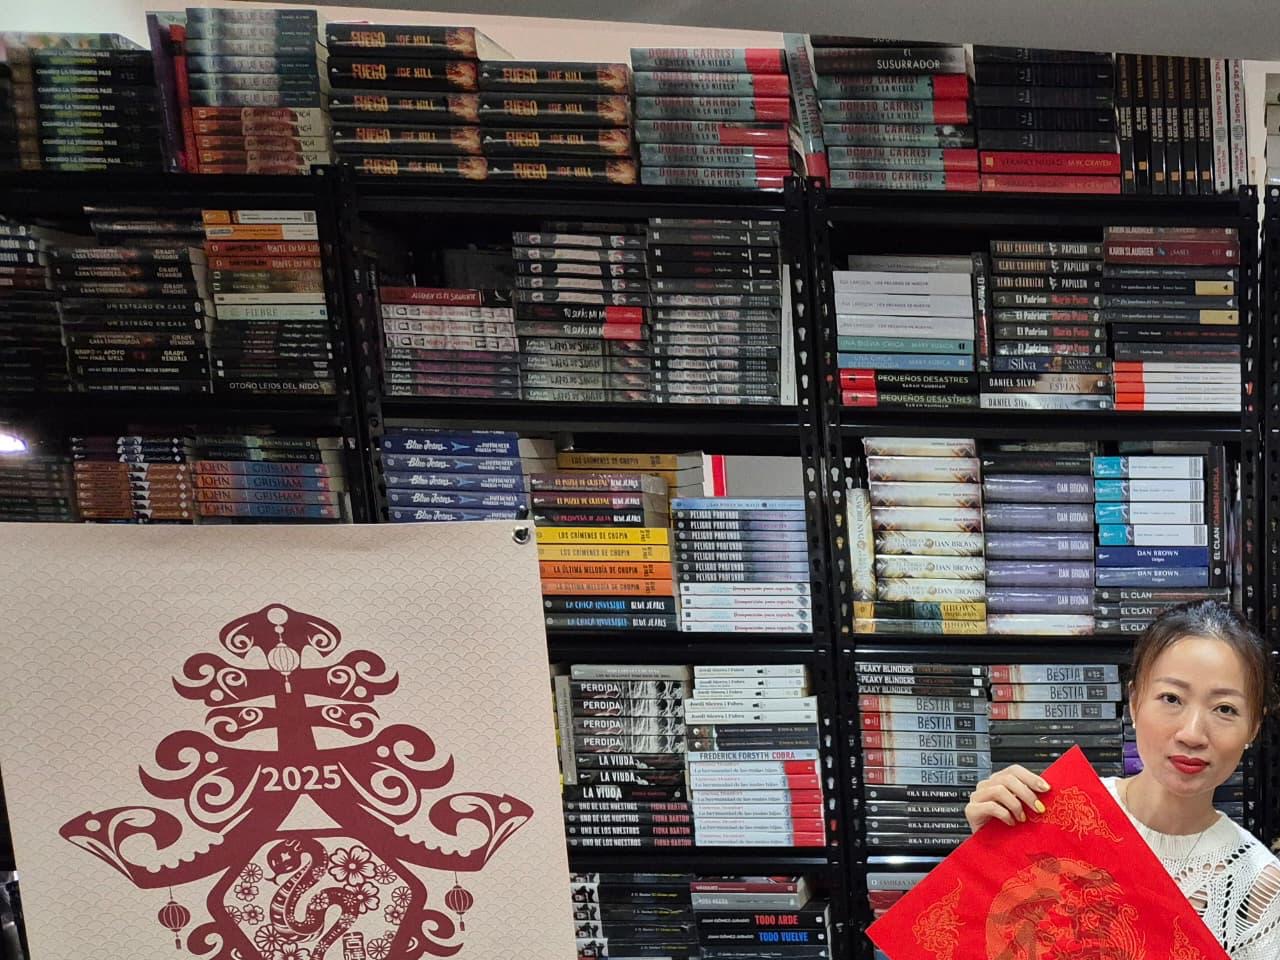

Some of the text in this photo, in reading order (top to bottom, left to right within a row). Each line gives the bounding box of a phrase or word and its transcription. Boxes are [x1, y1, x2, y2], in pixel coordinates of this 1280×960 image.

[876, 58, 941, 70] SUSURRADOR
[352, 63, 386, 80] FUEGO
[503, 67, 538, 84] FUEGO
[878, 373, 969, 385] PEQUEÑOS DESASTRES
[1136, 549, 1180, 558] DAN BROWN
[1120, 590, 1153, 600] EL CLAN
[859, 663, 914, 674] PEAKY BLINDERS
[580, 683, 620, 693] PERDIDA
[598, 755, 635, 766] LA VIUDA
[699, 751, 796, 760] FREDERICK FORSYTH COBRA
[261, 764, 342, 793] 2025
[754, 914, 799, 926] TODO ARDE
[758, 931, 809, 943] TODO VUELVE
